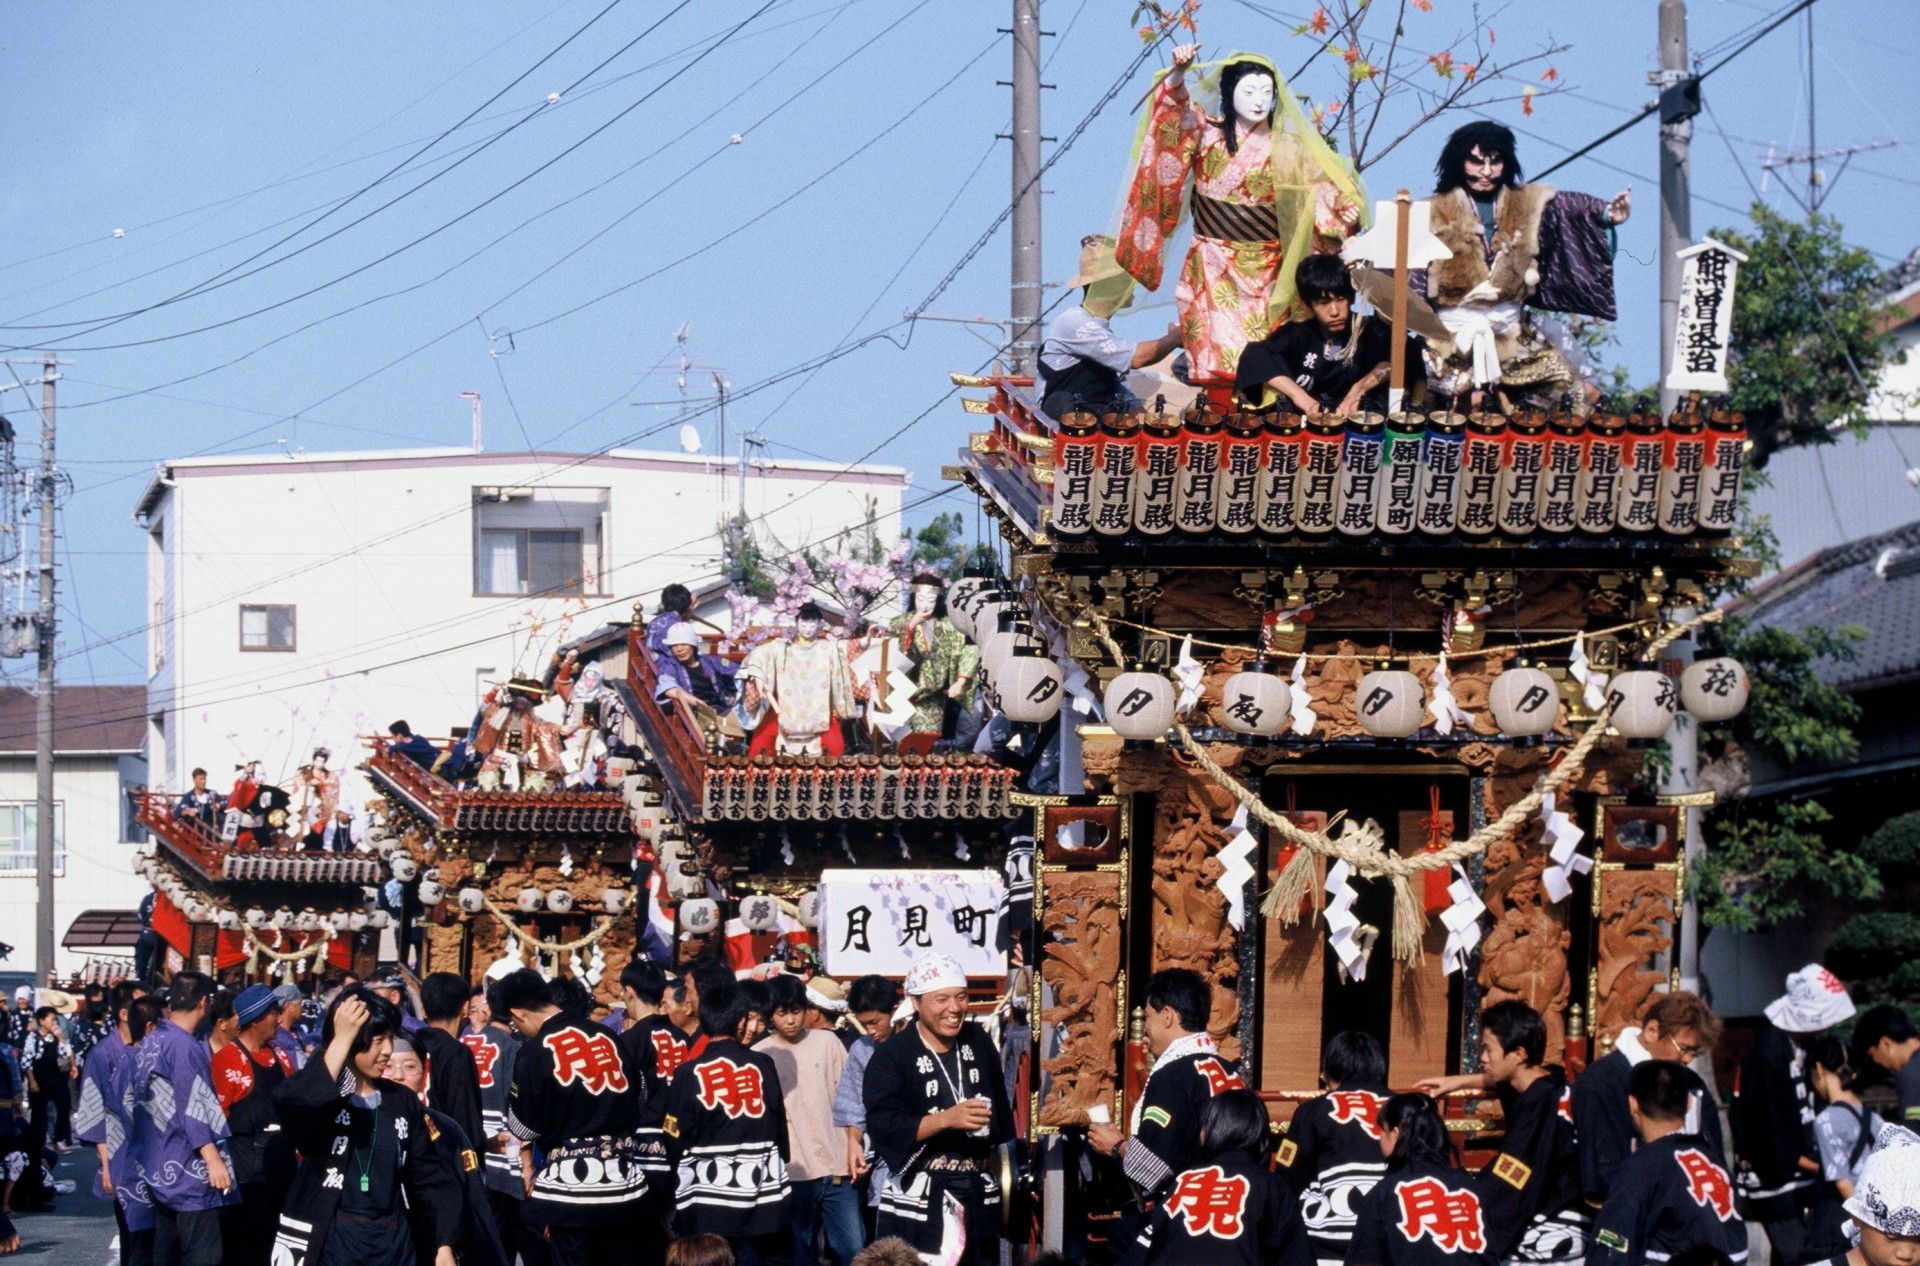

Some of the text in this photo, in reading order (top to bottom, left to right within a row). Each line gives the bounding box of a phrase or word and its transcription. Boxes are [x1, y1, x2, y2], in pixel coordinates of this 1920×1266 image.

[1058, 444, 1095, 528] 龍月殿
[1098, 444, 1134, 527] 龍月殿
[1141, 444, 1178, 527] 龍月殿
[1179, 440, 1220, 527] 龍月殿
[1221, 444, 1259, 527] 龍月殿
[1260, 444, 1298, 527] 龍月殿
[1301, 443, 1339, 527] 龍月殿
[1341, 444, 1379, 528] 龍月殿
[1422, 442, 1461, 528] 龍月殿
[1462, 442, 1500, 528] 龍月殿
[1503, 442, 1542, 527] 龍月殿
[1542, 440, 1581, 527] 龍月殿
[1581, 441, 1618, 527] 龍月殿
[1624, 442, 1662, 524] 龍月殿
[1667, 442, 1702, 526] 龍月殿
[1706, 440, 1742, 524] 龍月殿
[839, 903, 996, 953] 月見町
[543, 1026, 629, 1096] 月見
[693, 1057, 766, 1119] 月見
[1163, 1165, 1251, 1240] 月見
[1395, 1176, 1488, 1254] 月見
